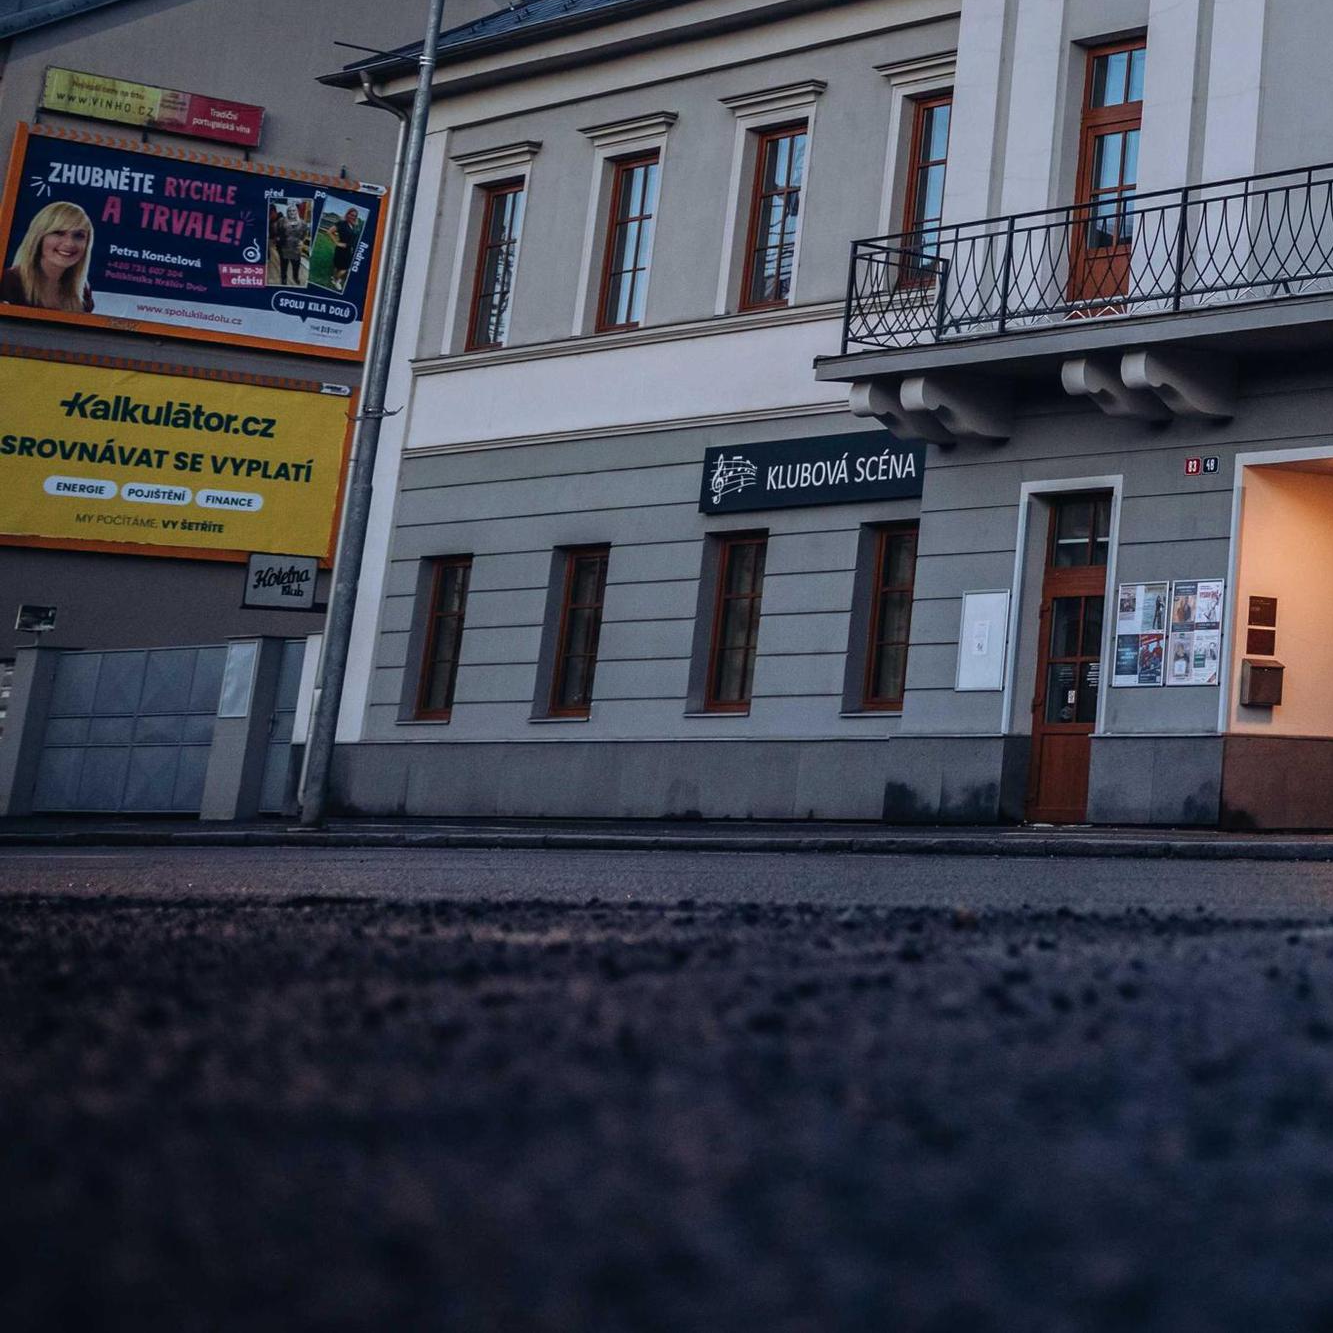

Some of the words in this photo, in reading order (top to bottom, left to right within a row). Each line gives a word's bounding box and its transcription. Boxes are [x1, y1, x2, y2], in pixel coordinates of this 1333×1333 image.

[48, 161, 155, 194] ZHUBNĚTE
[164, 176, 238, 205] RYCHLE
[264, 188, 285, 199] před
[313, 189, 327, 200] po
[101, 195, 122, 224] A
[139, 201, 245, 246] TRVALE!
[110, 244, 139, 259] Petra
[141, 249, 202, 268] Končelová
[352, 241, 369, 273] Andrea
[231, 275, 263, 286] efektu
[136, 303, 243, 326] www.spolukiladolu.cz
[279, 297, 305, 309] SPOLU
[307, 300, 327, 313] KILA
[328, 304, 351, 318] DOLŮ
[0, 434, 169, 469] SROVNÁVAT
[173, 451, 204, 473] SE
[210, 455, 315, 483] VYPLATÍ
[766, 452, 849, 490] KLUBOVÁ
[854, 448, 916, 483] SCÉNA
[55, 481, 106, 496] ENERGIE
[127, 485, 186, 502] POJIŠTĚNÍ
[205, 494, 254, 508] FINANCE
[75, 513, 94, 524] MY
[161, 519, 178, 530] VY
[180, 518, 225, 534] ŠETŘÍTE
